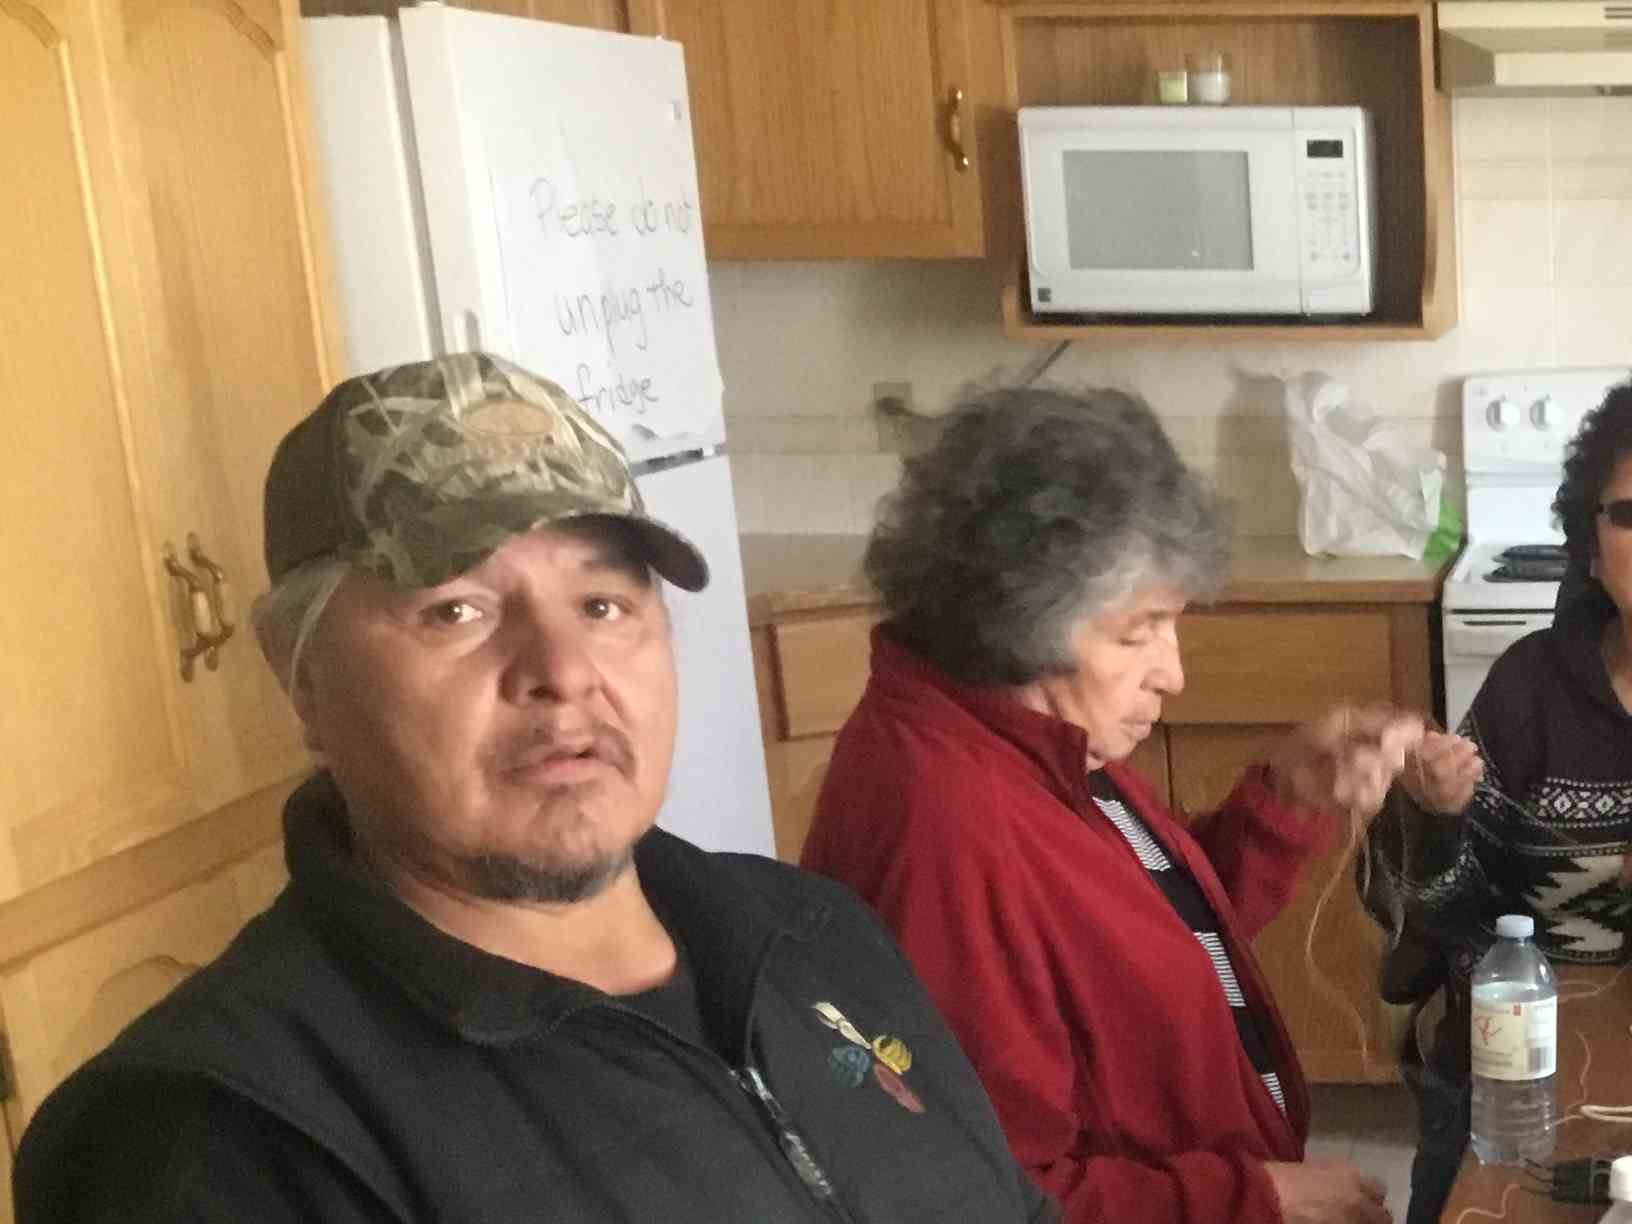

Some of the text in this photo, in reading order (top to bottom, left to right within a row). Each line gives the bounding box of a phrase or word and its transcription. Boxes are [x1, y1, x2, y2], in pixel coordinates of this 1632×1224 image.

[551, 266, 695, 359] unplug the
[576, 362, 660, 415] fridge
